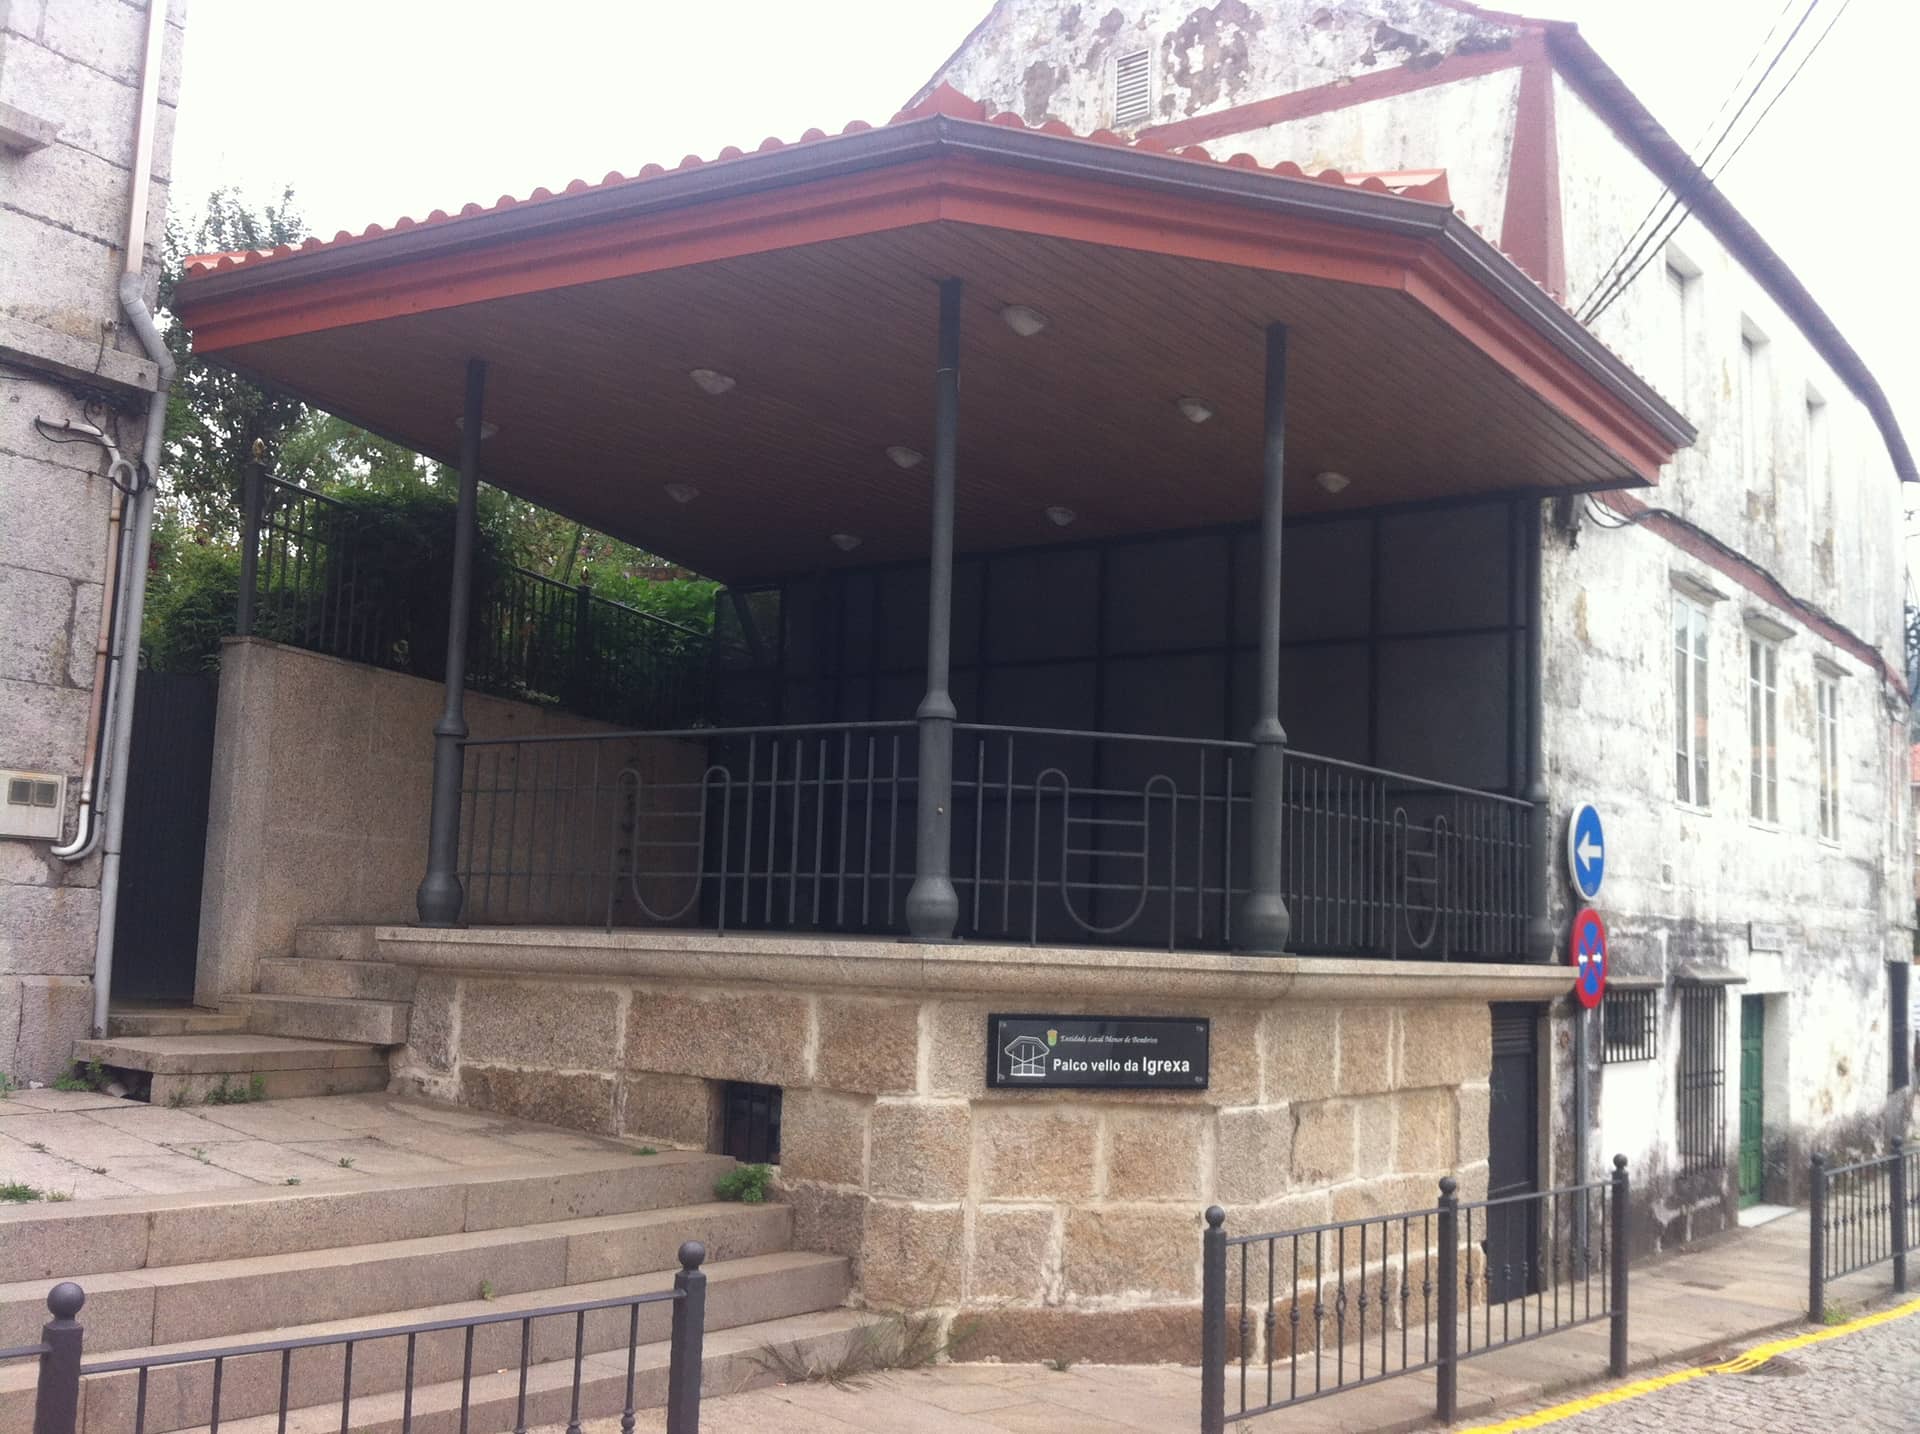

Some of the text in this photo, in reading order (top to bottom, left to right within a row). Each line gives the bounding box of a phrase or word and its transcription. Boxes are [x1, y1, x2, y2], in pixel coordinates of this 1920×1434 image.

[1087, 1034, 1104, 1043] Local
[1104, 1034, 1124, 1043] Menor
[1124, 1035, 1132, 1043] de
[1053, 1056, 1190, 1076] Palco vello da Igrexa
